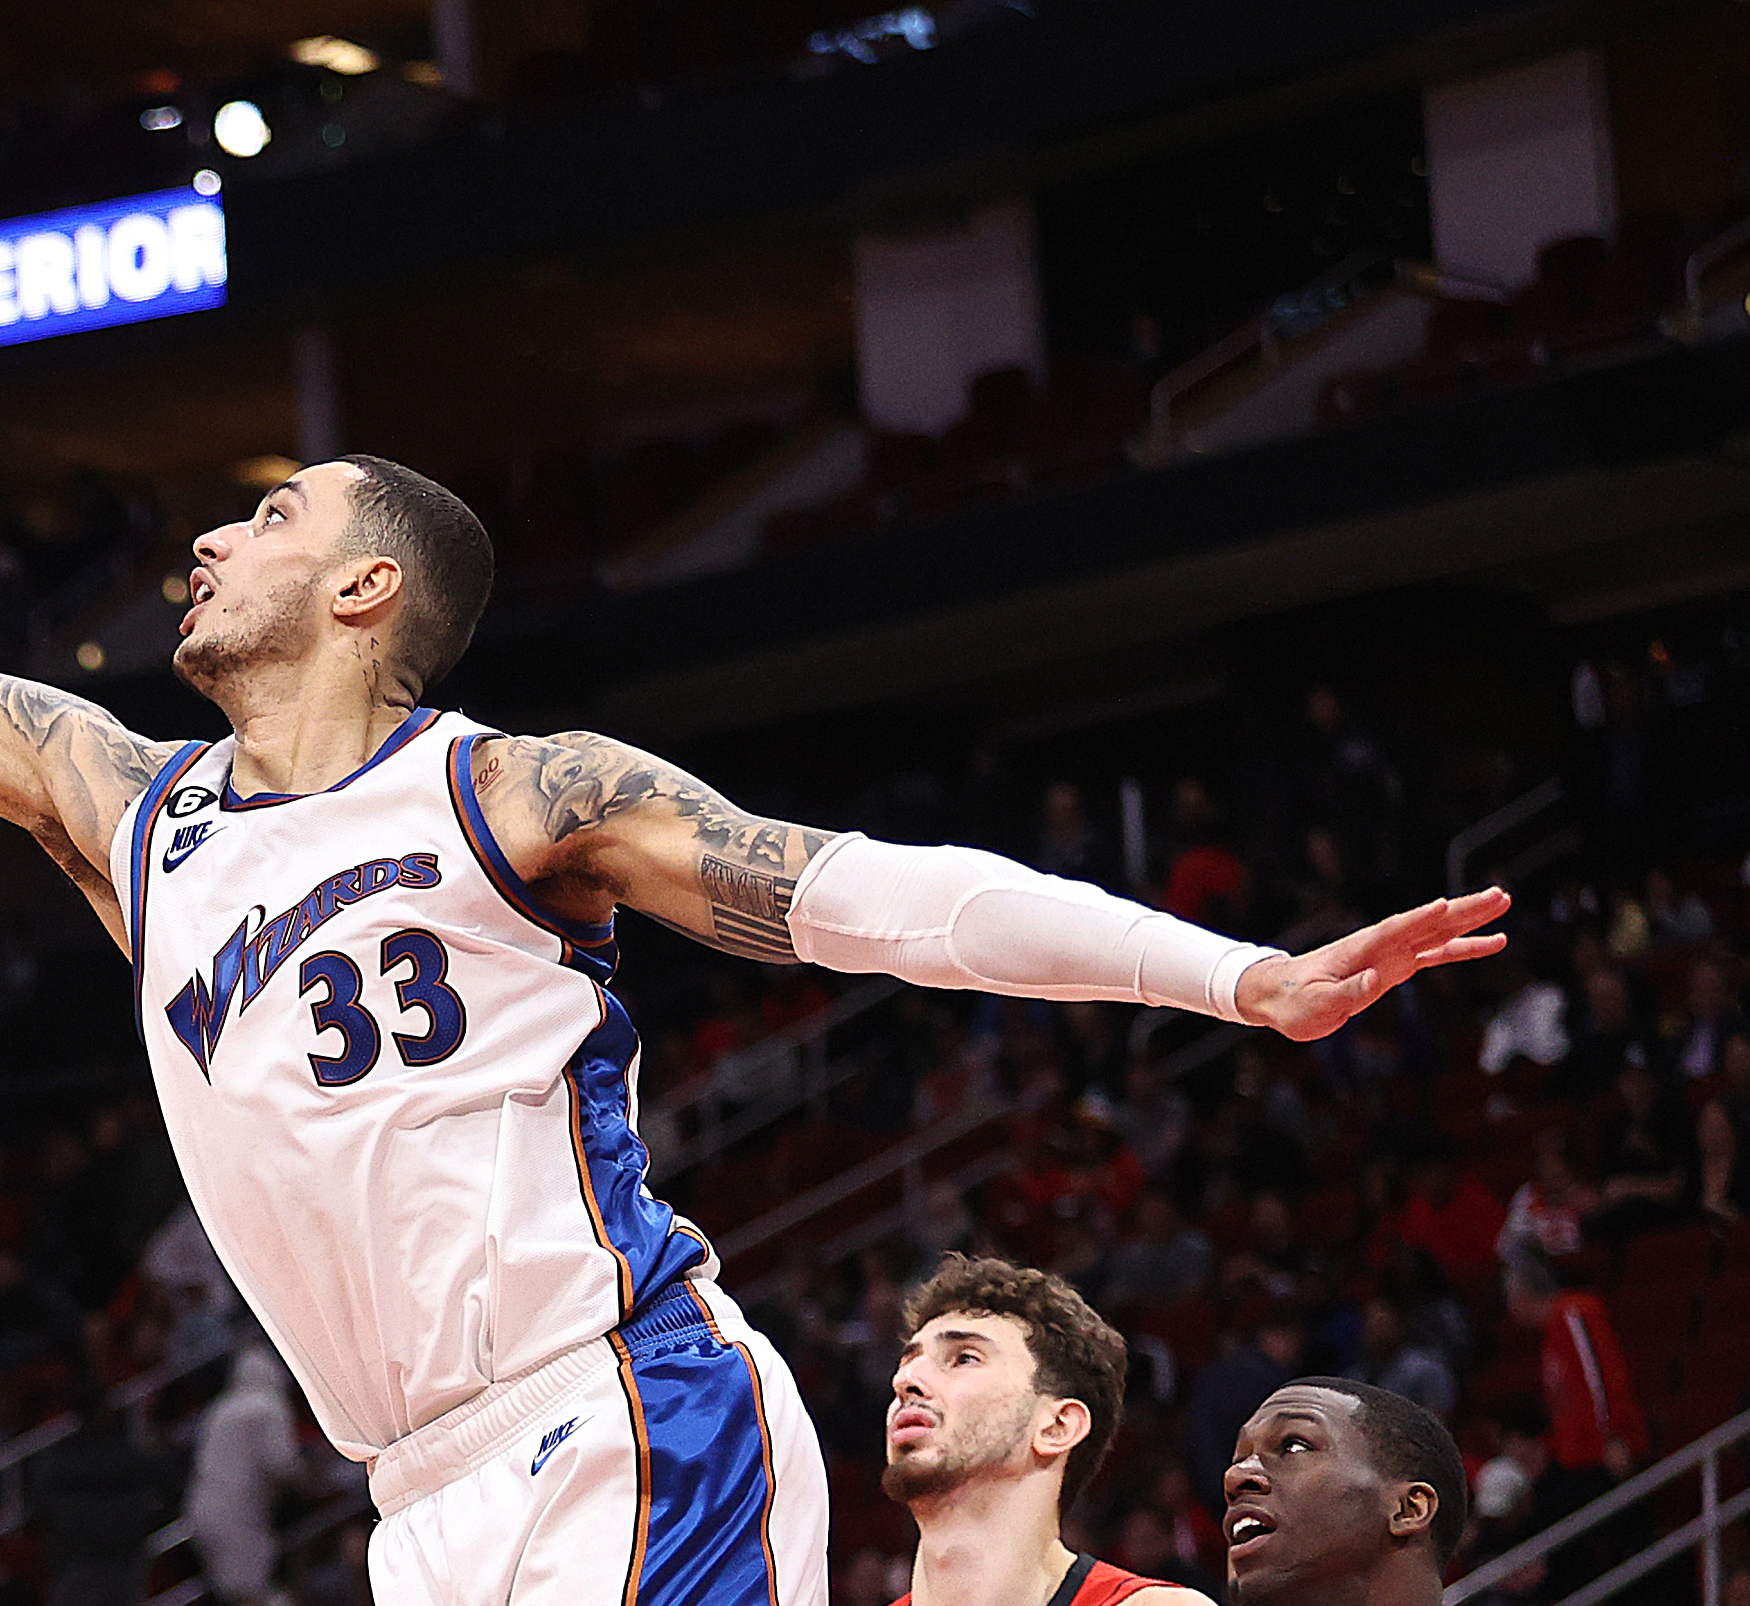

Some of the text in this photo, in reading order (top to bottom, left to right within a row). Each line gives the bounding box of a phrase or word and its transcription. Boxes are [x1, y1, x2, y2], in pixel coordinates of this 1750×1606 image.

[174, 789, 204, 814] 6
[170, 820, 213, 854] NIKE
[299, 927, 468, 1088] 33
[536, 1415, 580, 1459] NIKE
